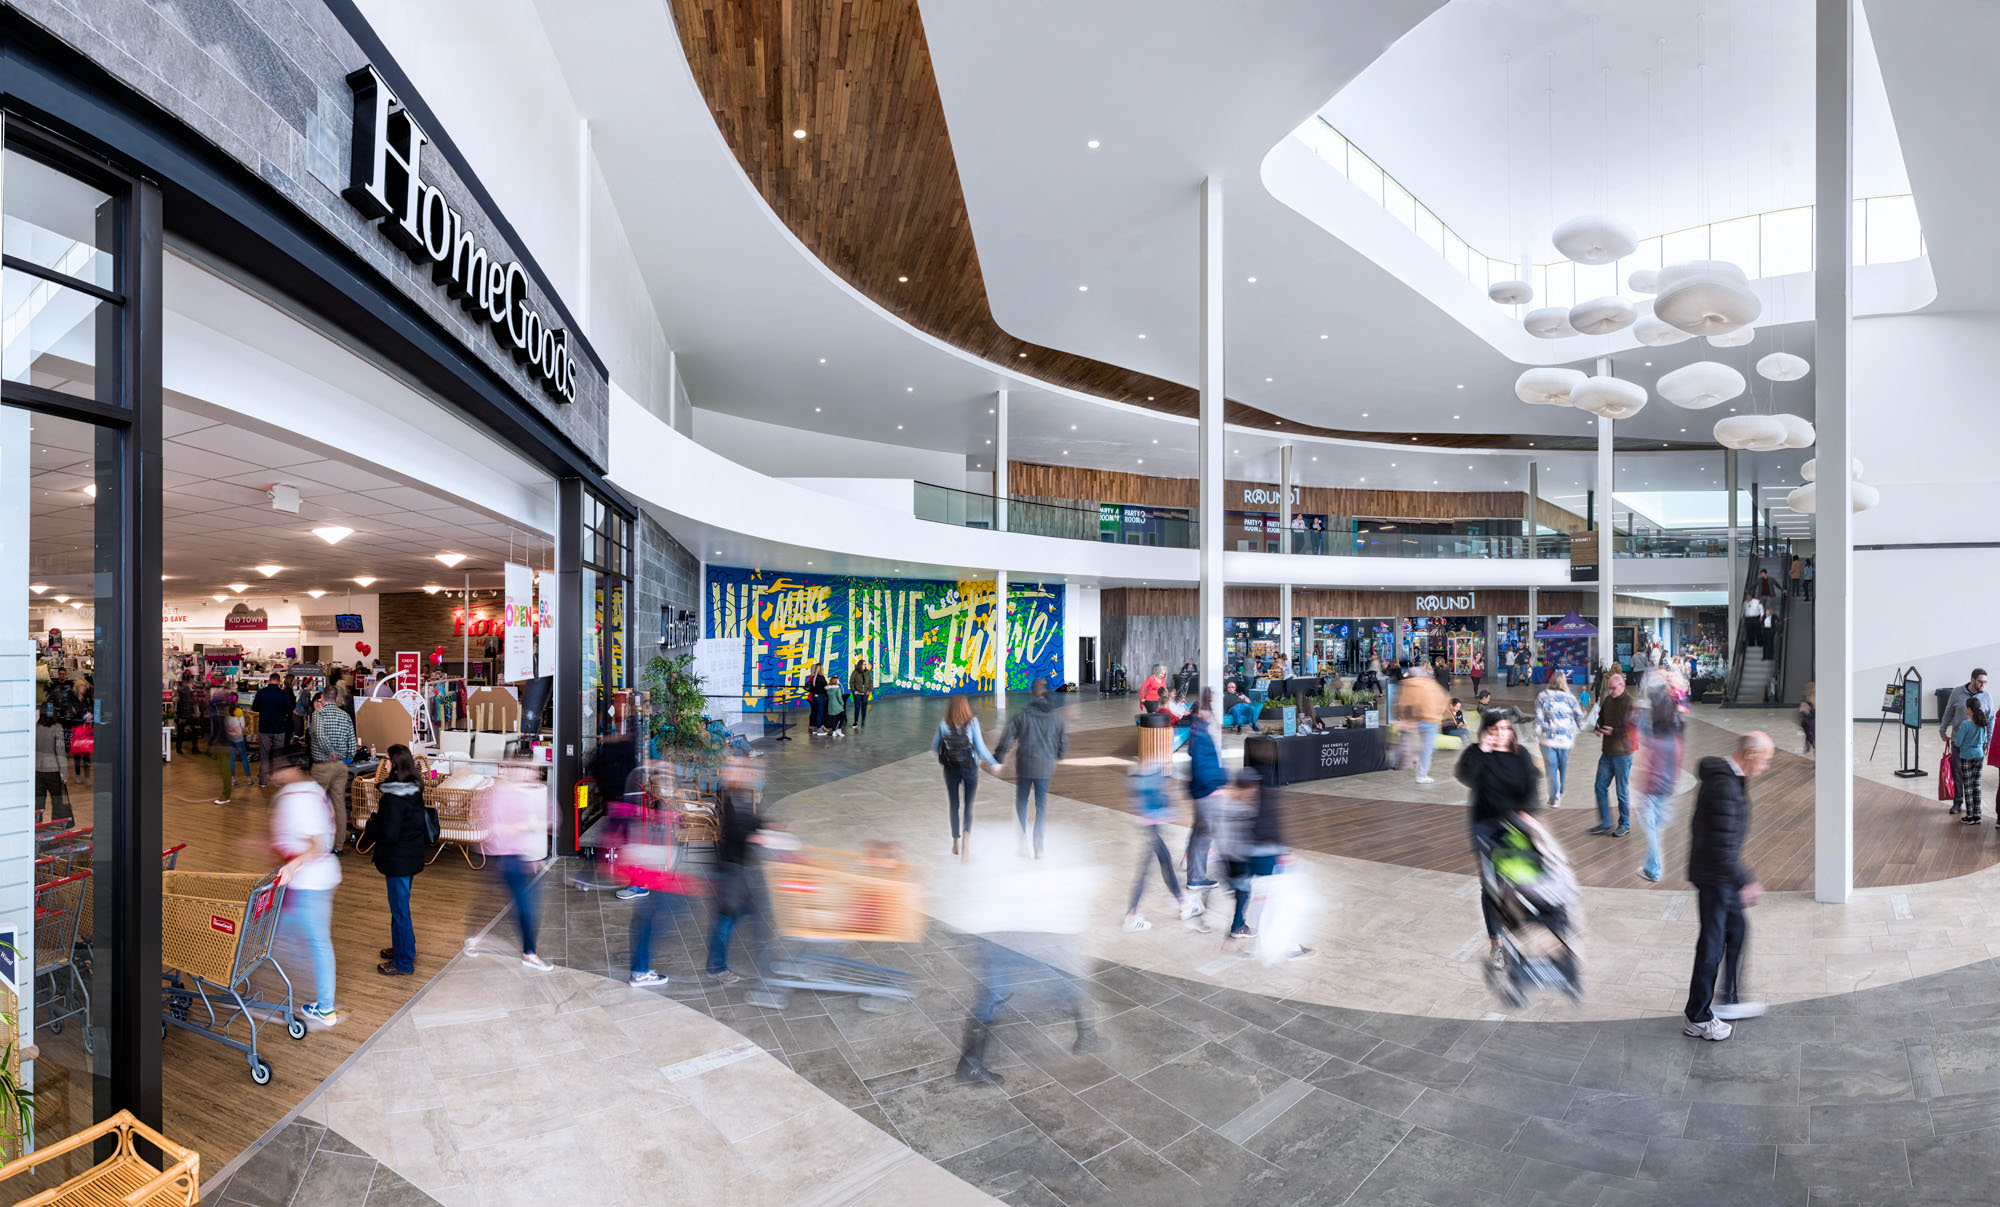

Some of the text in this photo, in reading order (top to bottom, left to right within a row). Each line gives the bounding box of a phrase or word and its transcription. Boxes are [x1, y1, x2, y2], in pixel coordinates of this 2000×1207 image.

[344, 63, 577, 404] HomeGoods
[1124, 509, 1140, 517] PARTY
[540, 600, 549, 614] GO
[773, 586, 830, 630] MAKE
[1416, 591, 1476, 611] ROUND1
[505, 603, 532, 627] OPEN
[848, 588, 926, 690] HIVE
[1320, 757, 1349, 767] TOWN
[1321, 747, 1350, 758] SOUTH
